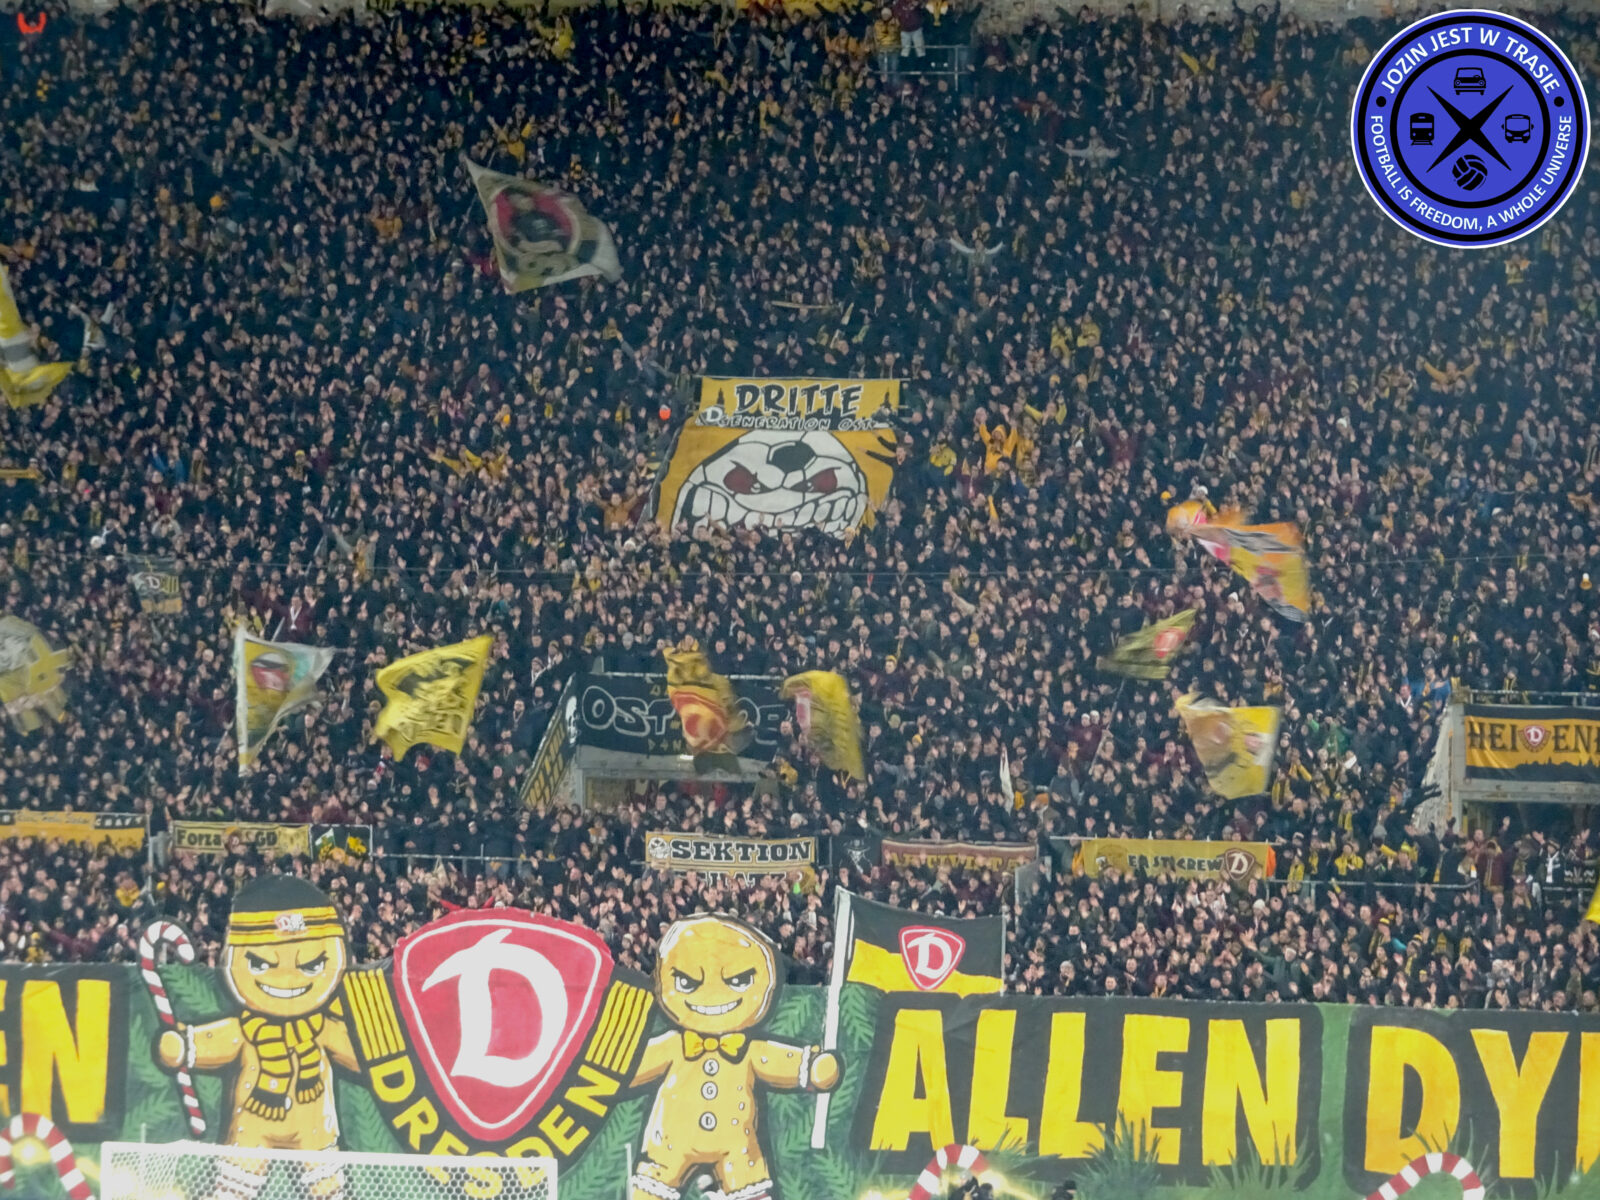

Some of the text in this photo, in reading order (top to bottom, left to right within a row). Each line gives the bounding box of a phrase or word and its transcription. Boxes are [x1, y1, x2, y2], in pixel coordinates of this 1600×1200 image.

[735, 384, 864, 417] DRITTE
[720, 414, 831, 431] GENERATION
[176, 829, 222, 846] Forza
[670, 839, 811, 862] SEKTION
[1176, 857, 1225, 872] CREW
[907, 933, 953, 979] D
[421, 929, 568, 1088] D
[869, 1009, 1300, 1166] ALLEN
[1364, 1026, 1600, 1178] DY
